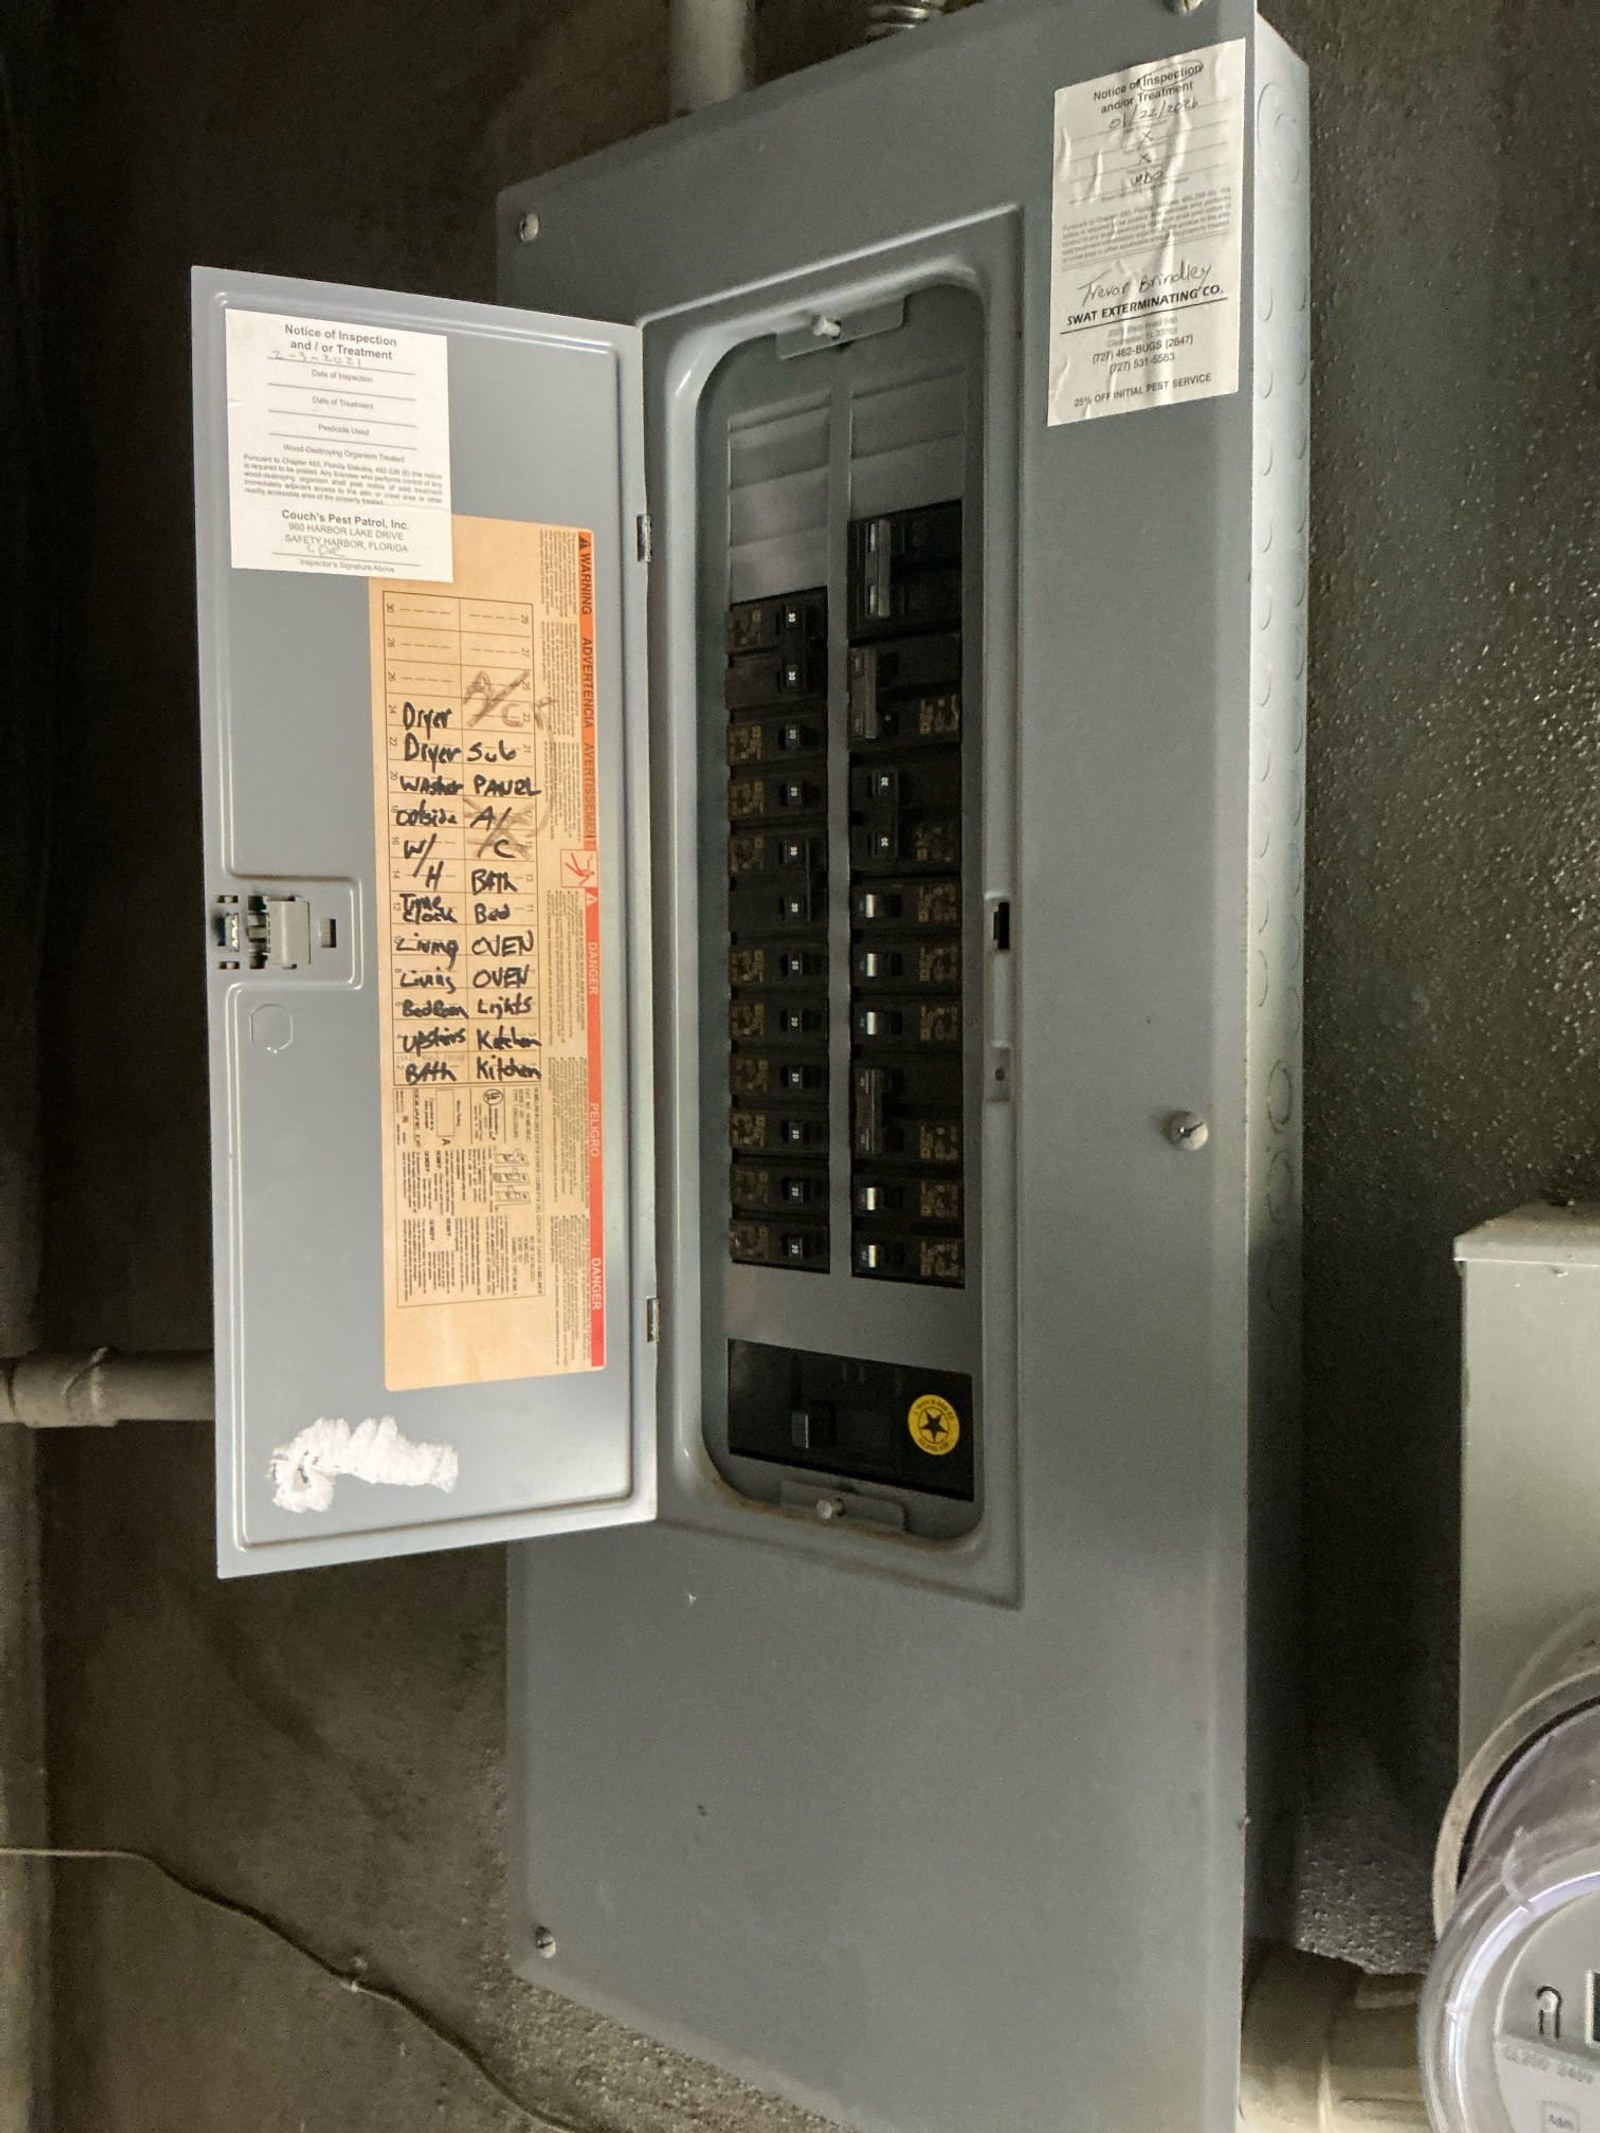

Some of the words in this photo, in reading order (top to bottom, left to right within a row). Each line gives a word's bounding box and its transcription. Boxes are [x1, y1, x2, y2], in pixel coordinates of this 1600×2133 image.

[1094, 85, 1126, 101] Notice
[1142, 64, 1202, 87] Inspection
[1101, 98, 1134, 114] and/or
[1138, 81, 1194, 102] Treatment
[1067, 310, 1098, 326] SWAT
[1102, 288, 1198, 318] EXTERMINATING
[1202, 284, 1224, 297] CO.
[284, 324, 321, 338] Notice
[324, 330, 337, 340] of
[338, 331, 397, 347] Inspection
[290, 339, 312, 350] and
[322, 344, 334, 352] or
[337, 344, 393, 360] Treatment
[312, 370, 328, 378] Date
[330, 371, 338, 379] of
[338, 372, 373, 384] Inspection
[1094, 392, 1111, 404] OFF
[1114, 386, 1143, 399] INITIAL
[1146, 381, 1168, 393] PEST
[1172, 372, 1212, 388] SERVICE
[312, 396, 329, 406] Date
[330, 398, 338, 406] of
[340, 399, 374, 410] Treatment
[351, 426, 370, 436] Used
[282, 509, 326, 522] Couch's
[328, 514, 352, 524] Pest
[354, 516, 388, 529] Patrol,
[391, 520, 410, 530] Inc.
[307, 523, 348, 536] HARBOR
[350, 528, 374, 538] LAKE
[375, 531, 404, 540] DRIVE
[284, 534, 322, 545] SAFETY
[368, 542, 408, 553] FLORIDA
[581, 552, 592, 615] WARNING
[582, 637, 594, 730] ADVERTENCIA
[402, 701, 452, 740] Dryer
[472, 930, 534, 958] OVEN
[473, 964, 530, 989] OVEN
[588, 942, 599, 996] DANGER
[591, 1102, 599, 1158] PELIGRO
[591, 1257, 601, 1310] DANGER
